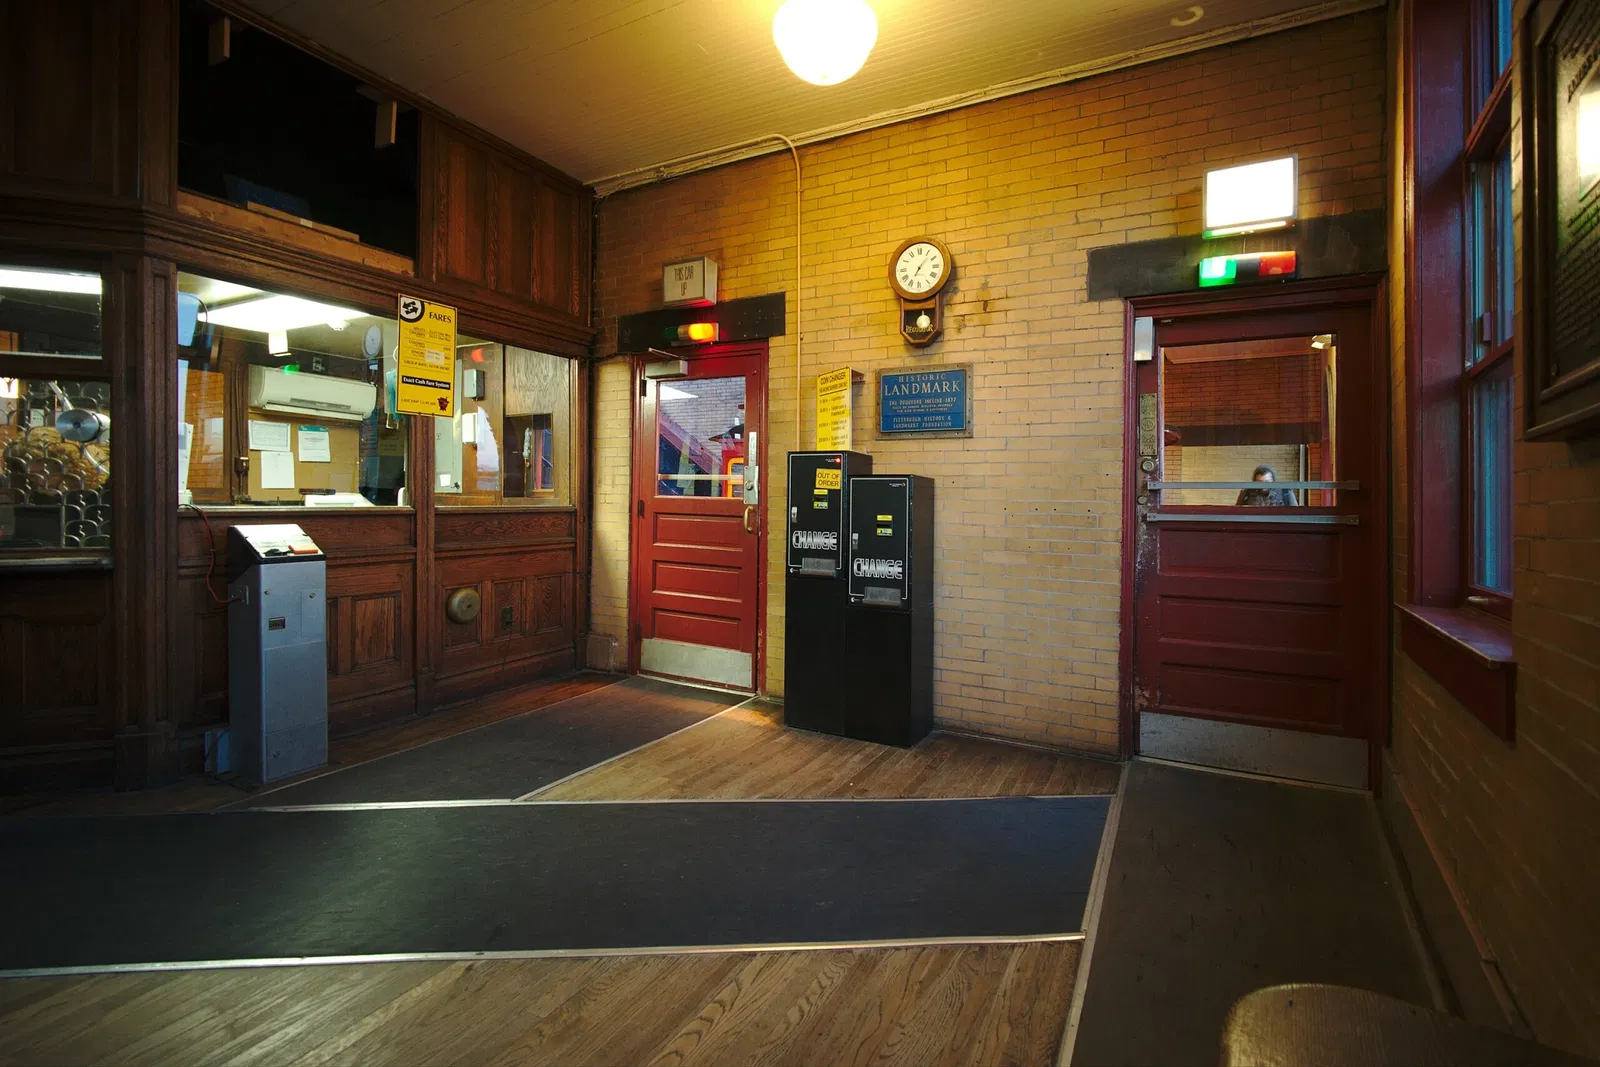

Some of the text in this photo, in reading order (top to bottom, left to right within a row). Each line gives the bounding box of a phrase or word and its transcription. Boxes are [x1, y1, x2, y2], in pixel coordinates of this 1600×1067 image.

[674, 265, 694, 282] THIS CAR
[680, 282, 688, 296] UP
[429, 311, 452, 323] FARES
[820, 371, 846, 386] COIN CHANGER
[898, 373, 946, 383] HISTORIC
[885, 380, 961, 396] LANDMARK
[817, 479, 839, 487] ORDER
[792, 530, 837, 551] CHANGE
[853, 557, 903, 580] CHANGE
